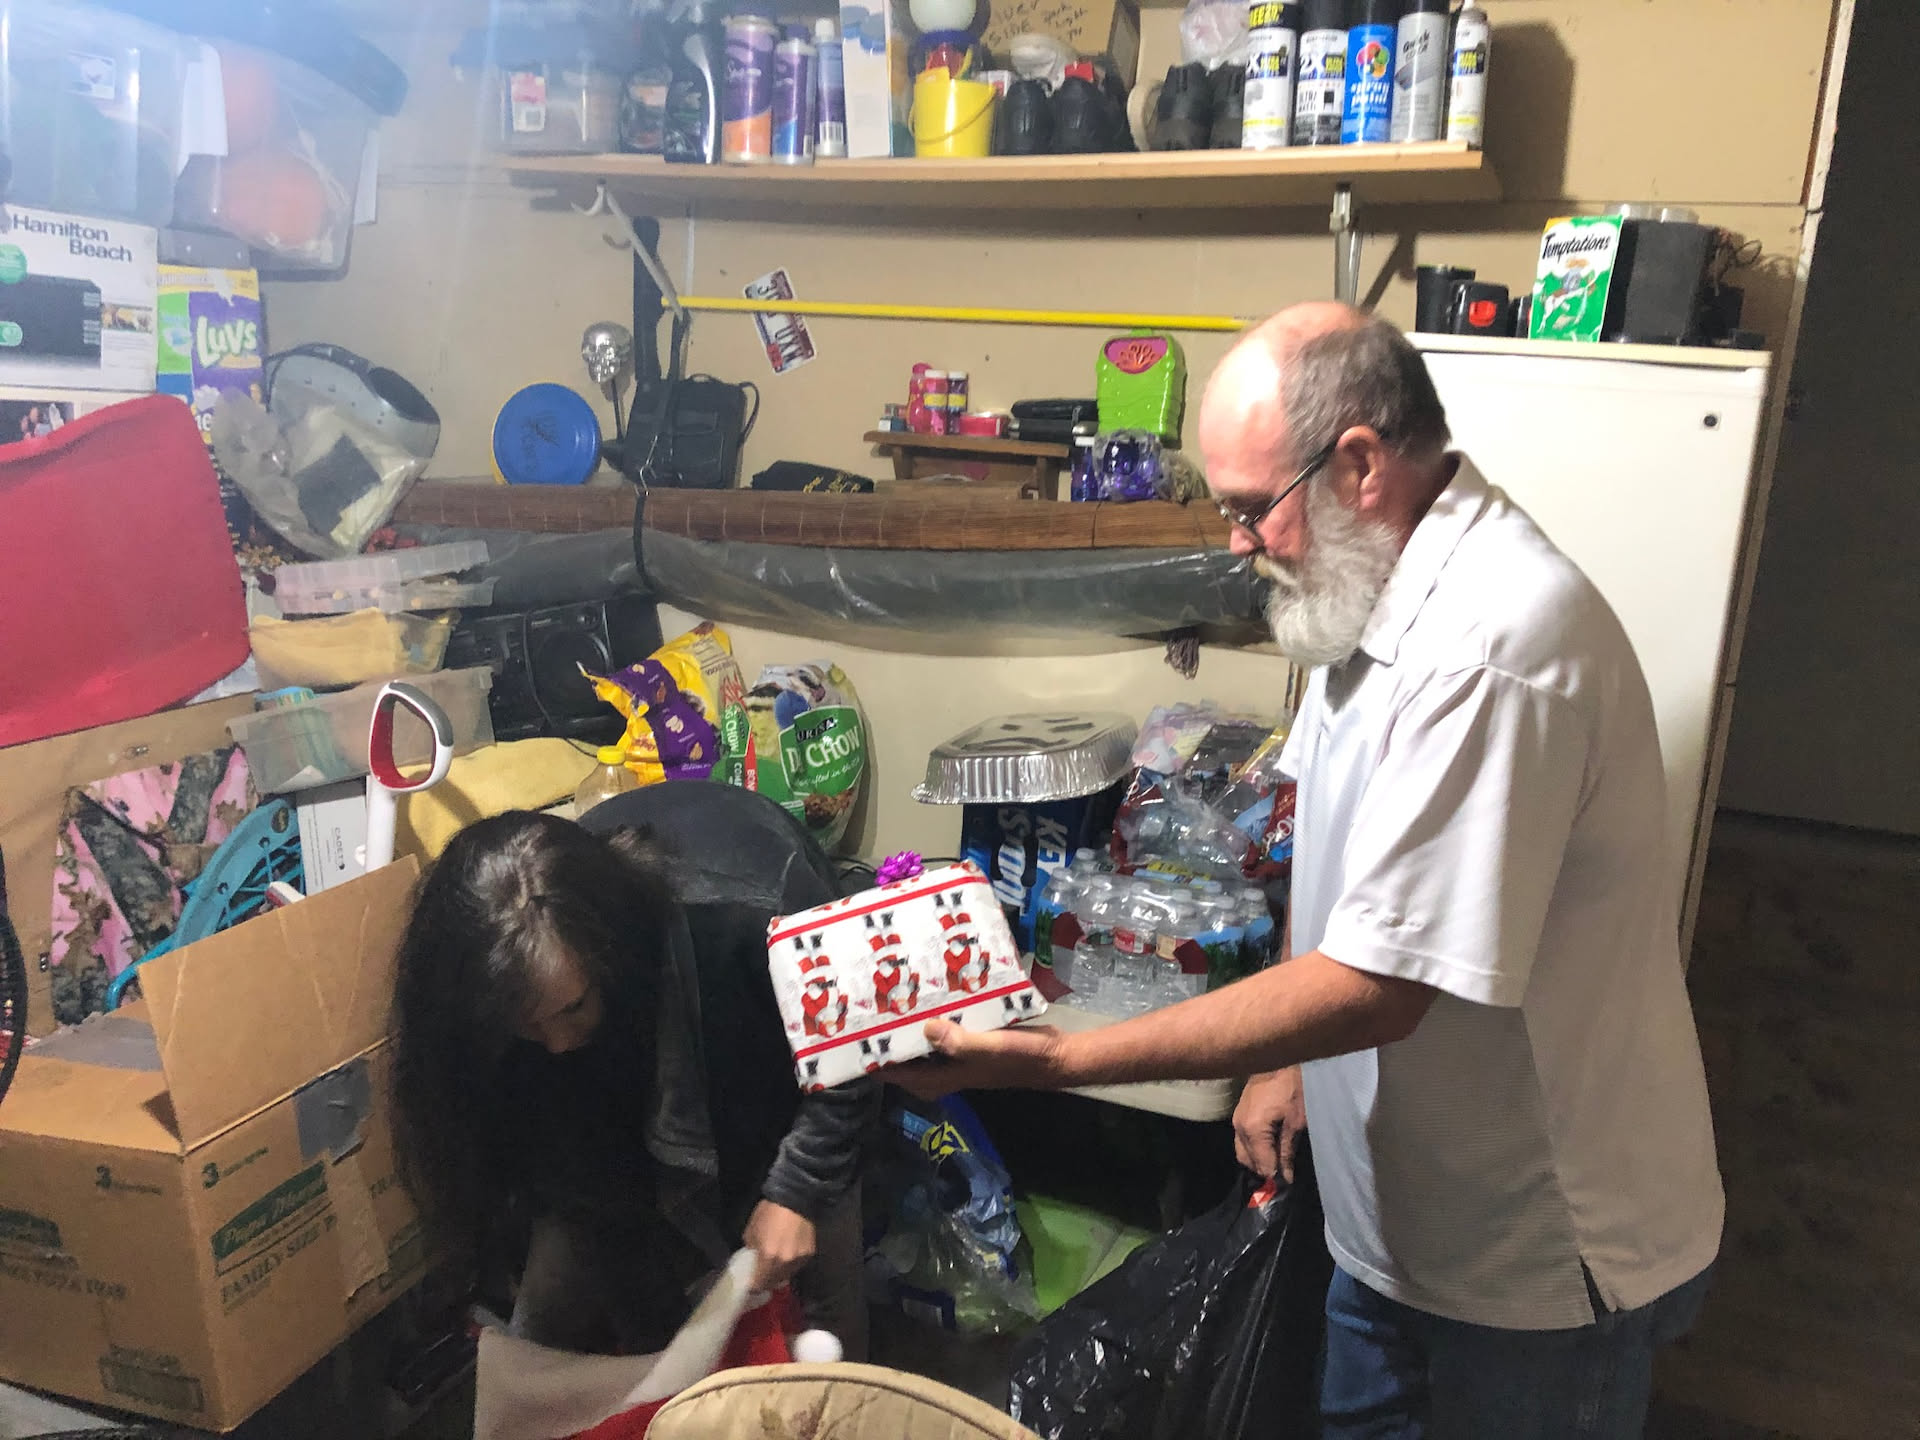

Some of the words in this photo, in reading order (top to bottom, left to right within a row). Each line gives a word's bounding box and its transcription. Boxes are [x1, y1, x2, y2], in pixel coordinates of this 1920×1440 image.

[13, 214, 109, 242] Hamilton
[69, 238, 132, 262] Beach
[1542, 233, 1610, 262] Temptations
[196, 315, 257, 368] Luvs
[805, 726, 860, 768] CHOW
[733, 762, 744, 787] COMP
